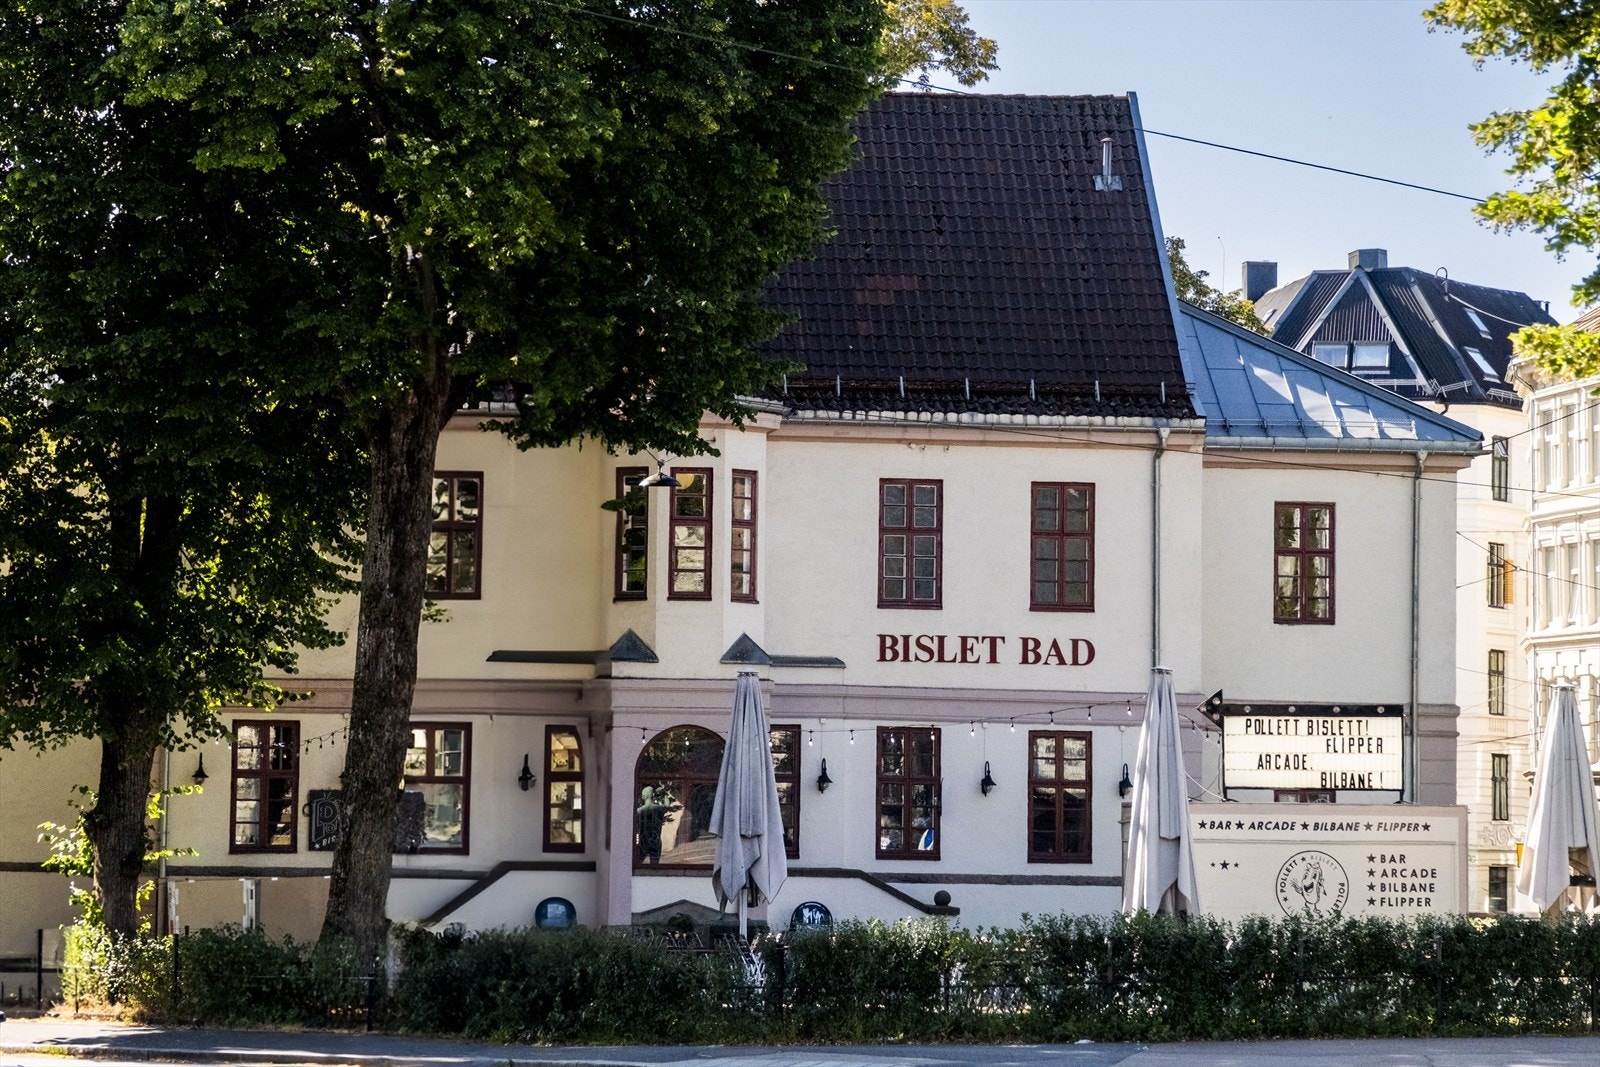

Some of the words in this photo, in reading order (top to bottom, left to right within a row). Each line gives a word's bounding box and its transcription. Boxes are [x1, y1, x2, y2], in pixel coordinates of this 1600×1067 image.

[876, 633, 1006, 664] BISLET
[1019, 636, 1096, 667] BAD
[1245, 718, 1300, 736] POLLETT
[1307, 719, 1369, 736] BISLETT!
[1326, 737, 1383, 754] FLIPPER
[1257, 754, 1313, 771] ARCADE.
[1208, 820, 1232, 831] BAR
[1248, 821, 1296, 831] ARCADE
[1313, 821, 1360, 832] BILBANE
[1376, 822, 1420, 833] FLIPPER
[1380, 853, 1407, 865] BAR
[1279, 859, 1299, 894] POLLETT
[1380, 868, 1438, 879] ARCADE
[1380, 882, 1436, 893] BILBANE
[1380, 897, 1432, 908] FLIPPER
